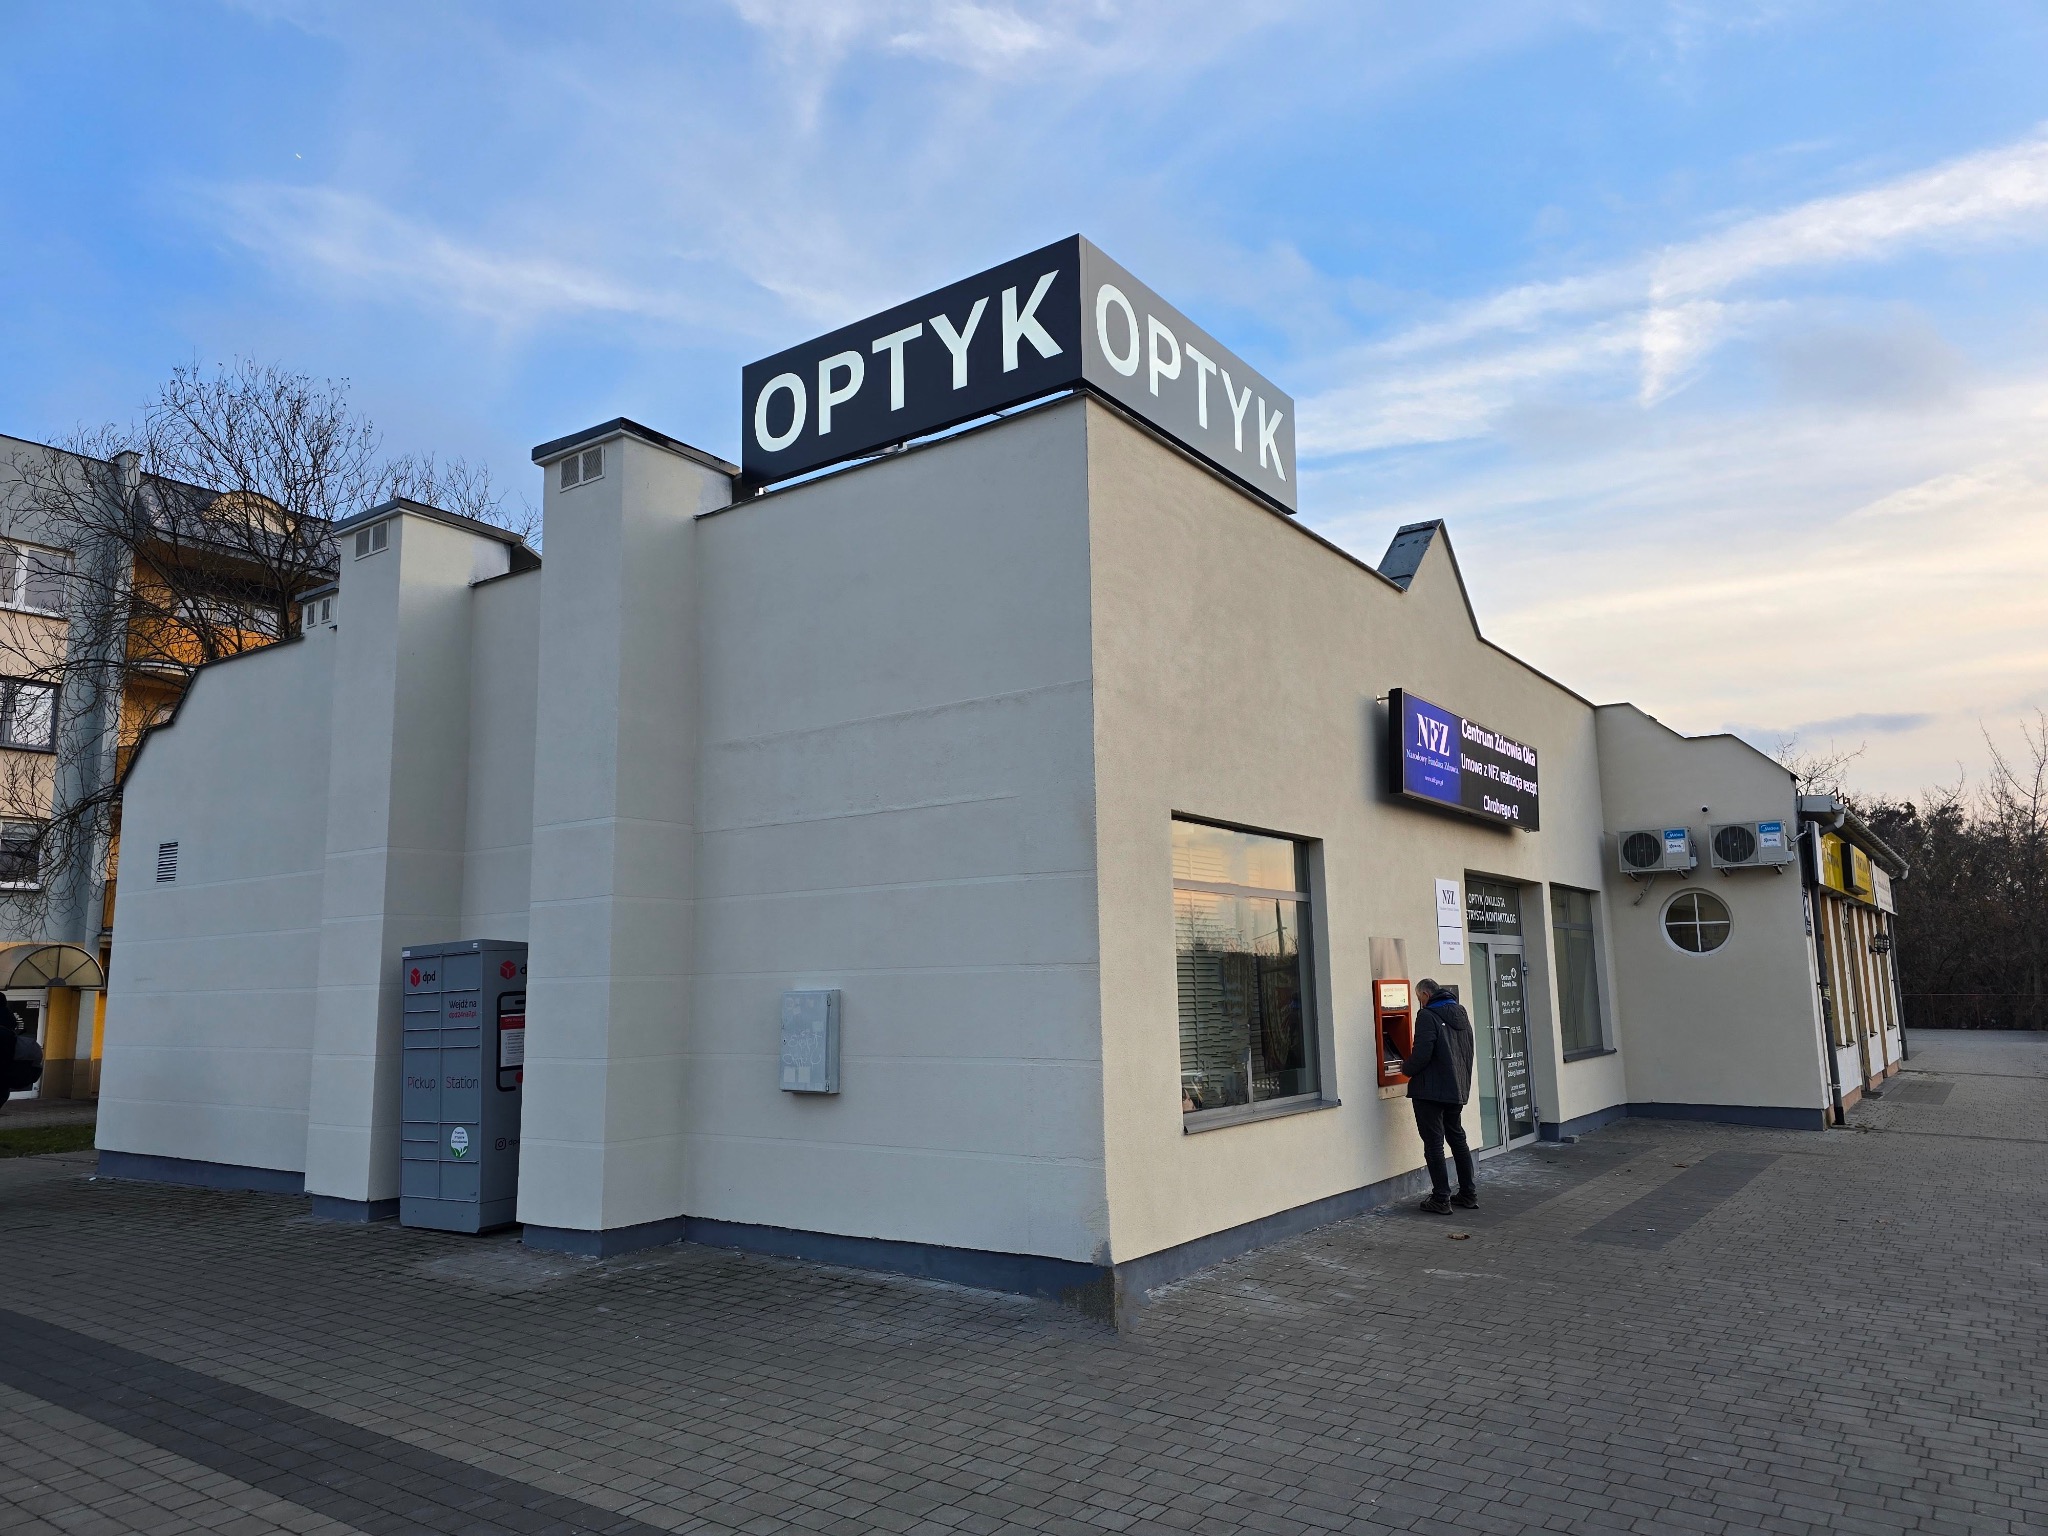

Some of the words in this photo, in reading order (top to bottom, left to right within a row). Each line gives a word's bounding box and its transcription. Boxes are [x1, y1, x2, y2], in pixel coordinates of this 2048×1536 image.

[754, 269, 1064, 452] OPTYK
[1096, 283, 1288, 482] OPTYK
[1416, 713, 1450, 757] NFZ
[1461, 718, 1494, 749] Centrum
[1495, 732, 1522, 761] Zdrowia
[1523, 745, 1536, 767] Oka
[1461, 752, 1483, 775] Umowa
[1483, 765, 1488, 777] z
[1488, 763, 1500, 782] NFZ
[1500, 769, 1523, 792] realizacja
[1512, 804, 1519, 820] 42
[1442, 889, 1456, 906] NFZ
[1468, 893, 1484, 905] OPTYK
[1485, 895, 1506, 908] OKULISTA
[1486, 911, 1517, 924] KONTAKTOLOG
[422, 971, 436, 984] dpd
[448, 1000, 469, 1010] Wejdź
[407, 1076, 437, 1091] Pickup
[446, 1075, 479, 1089] Station
